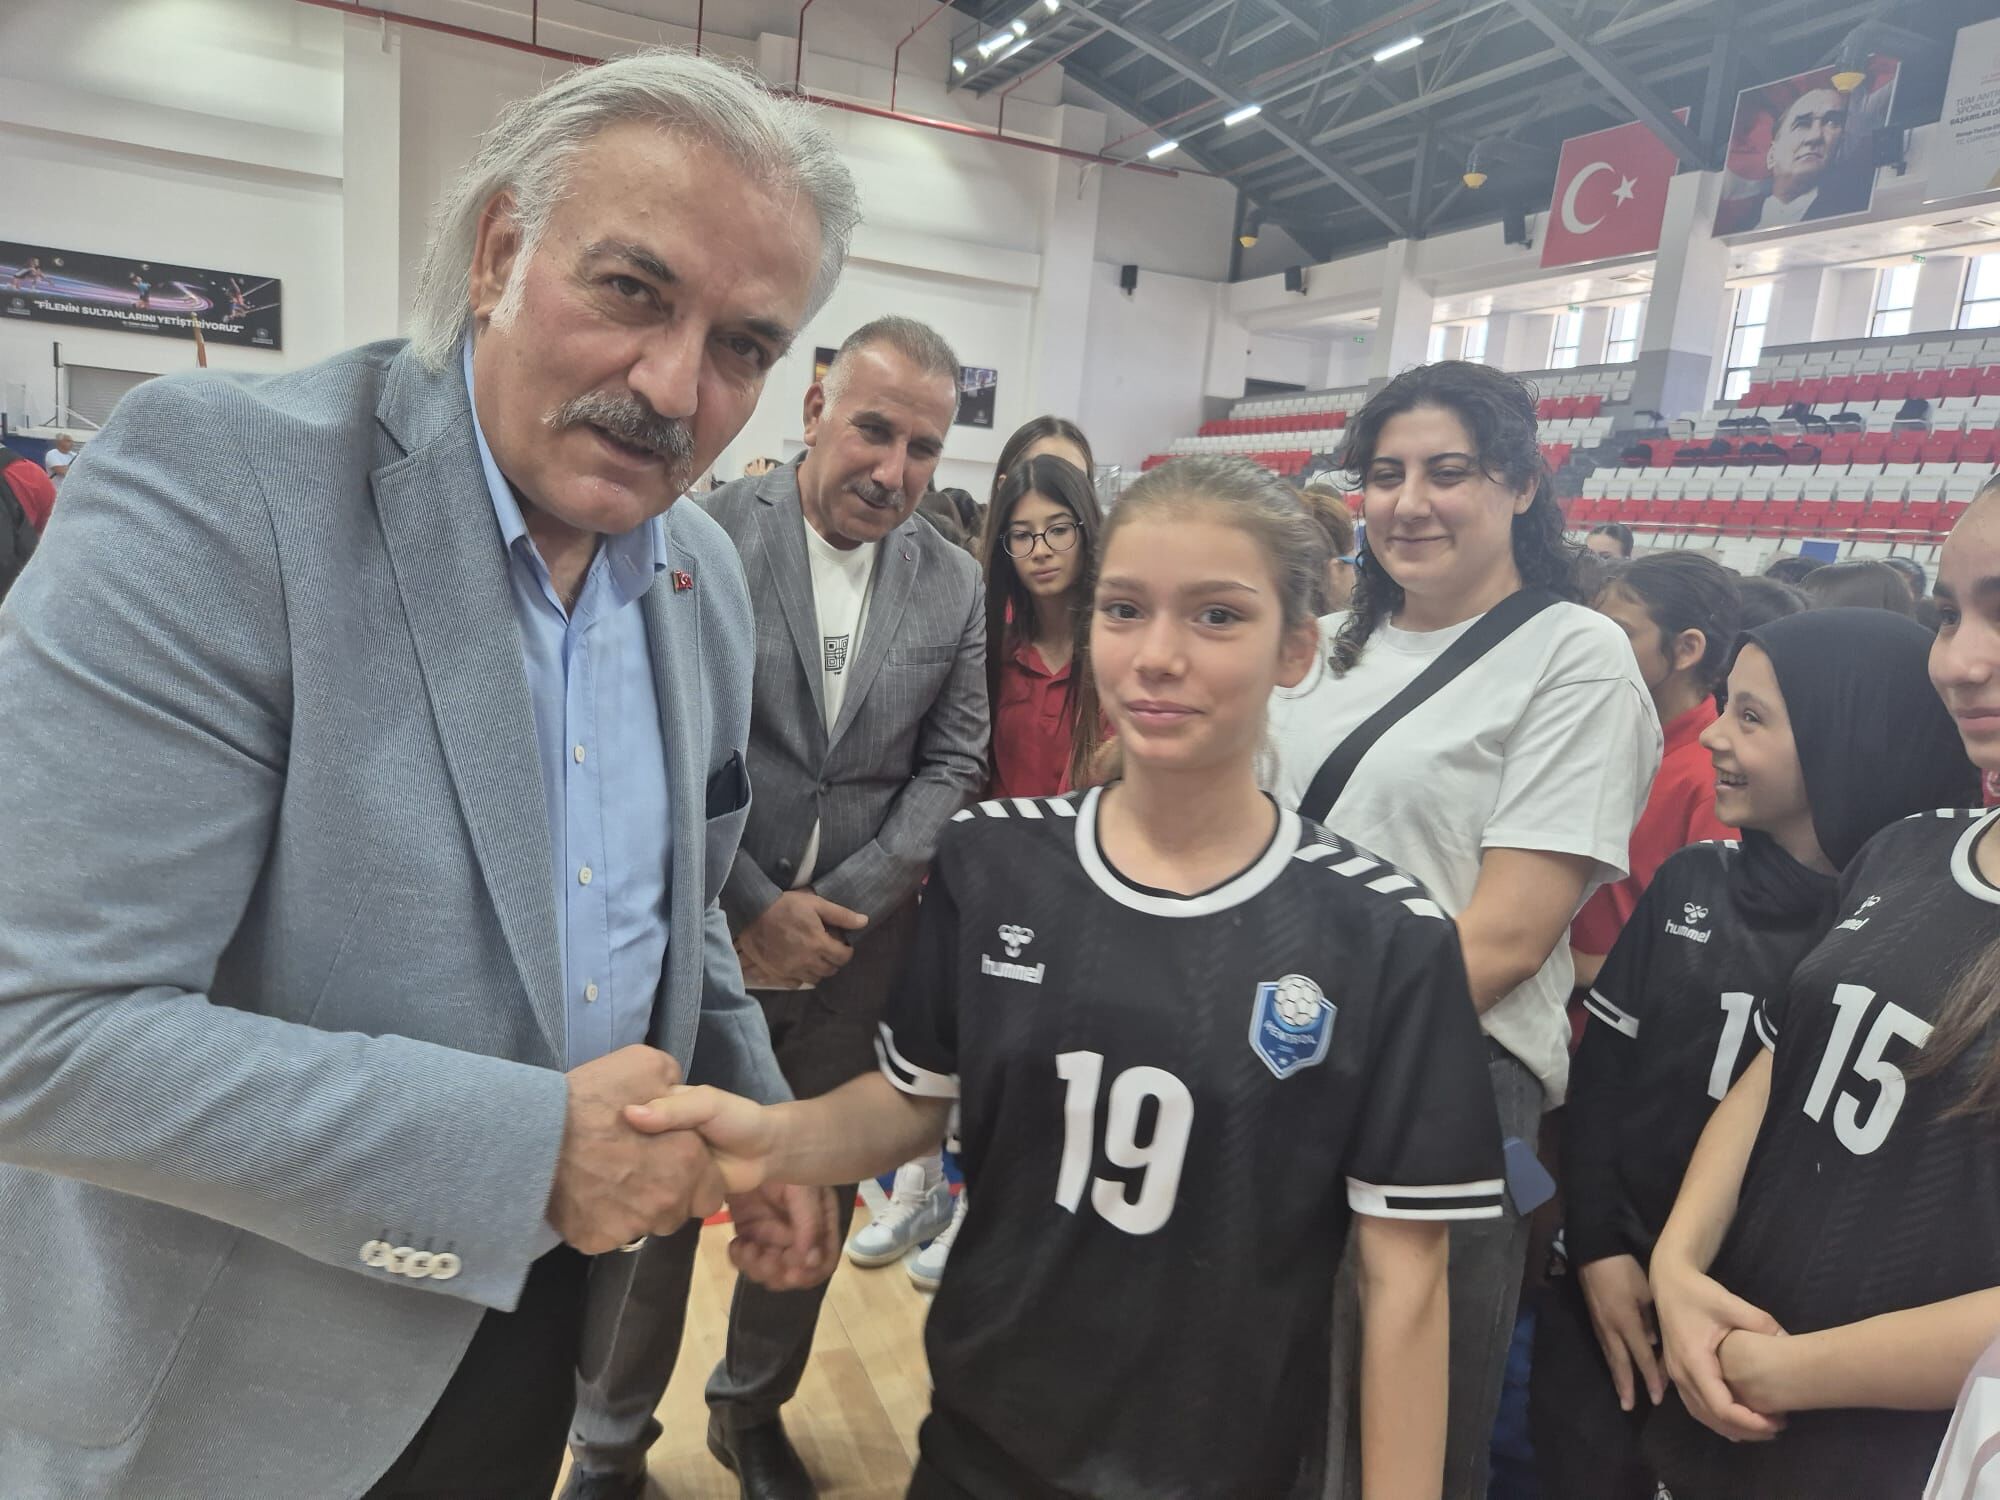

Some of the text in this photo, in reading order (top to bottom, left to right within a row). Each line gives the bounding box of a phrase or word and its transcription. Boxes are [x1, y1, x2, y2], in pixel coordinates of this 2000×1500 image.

[81, 305, 156, 322] SULTANLARINI
[1665, 919, 1711, 943] hummel
[1803, 983, 1935, 1156] 15
[1055, 1050, 1195, 1235] 19
